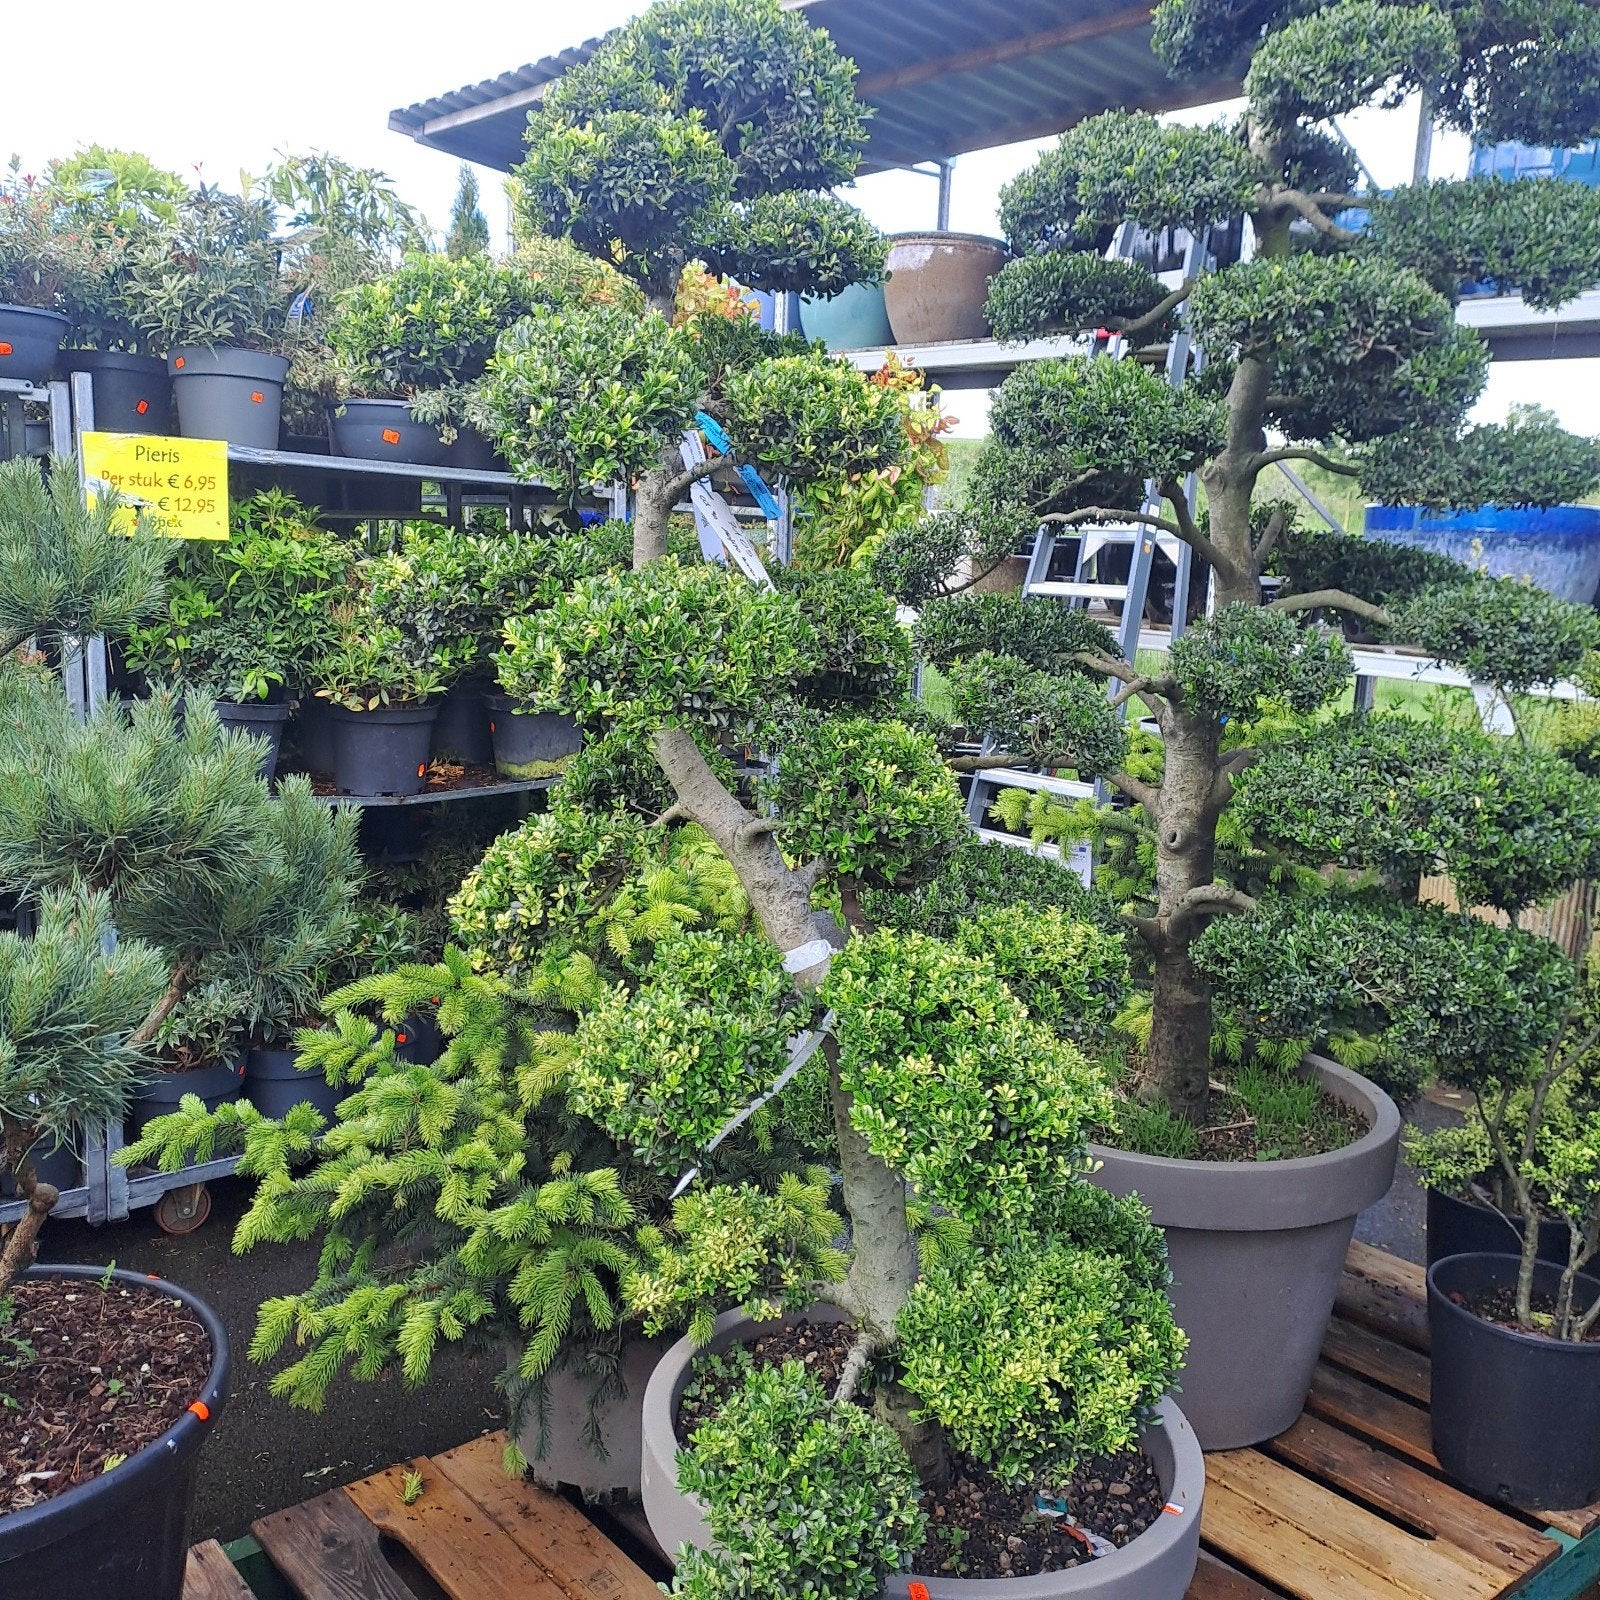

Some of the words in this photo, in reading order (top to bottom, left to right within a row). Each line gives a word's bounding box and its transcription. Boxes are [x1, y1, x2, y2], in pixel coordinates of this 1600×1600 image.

[135, 445, 180, 463] Pieris
[101, 470, 124, 485] Per
[129, 472, 163, 487] stuk
[168, 474, 180, 489] €
[184, 475, 216, 491] 6,95
[158, 497, 170, 512] €
[174, 498, 215, 514] 12,95
